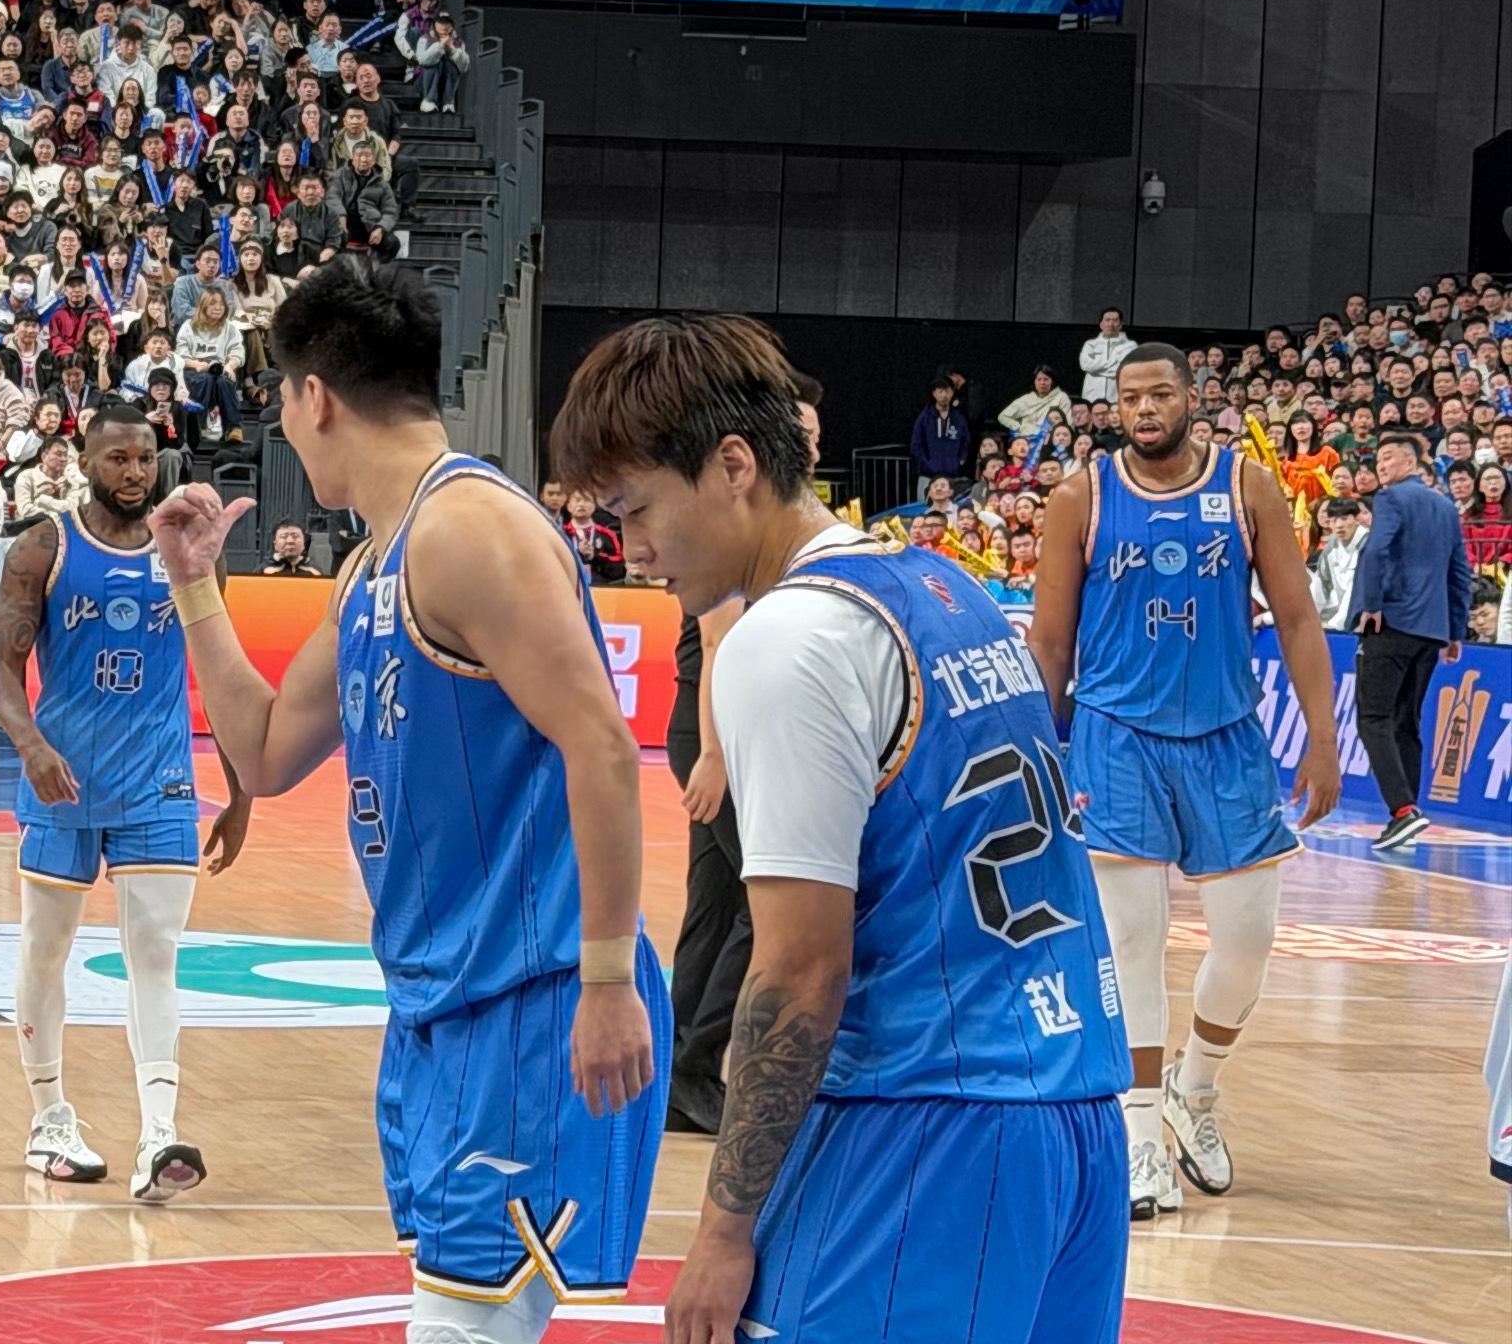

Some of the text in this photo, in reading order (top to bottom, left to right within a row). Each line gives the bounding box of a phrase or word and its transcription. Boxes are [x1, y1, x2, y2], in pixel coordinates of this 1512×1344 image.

[1145, 596, 1197, 642] 14
[94, 648, 144, 695] 10
[931, 636, 1045, 718] 北汽极
[1023, 970, 1083, 1038] 赵
